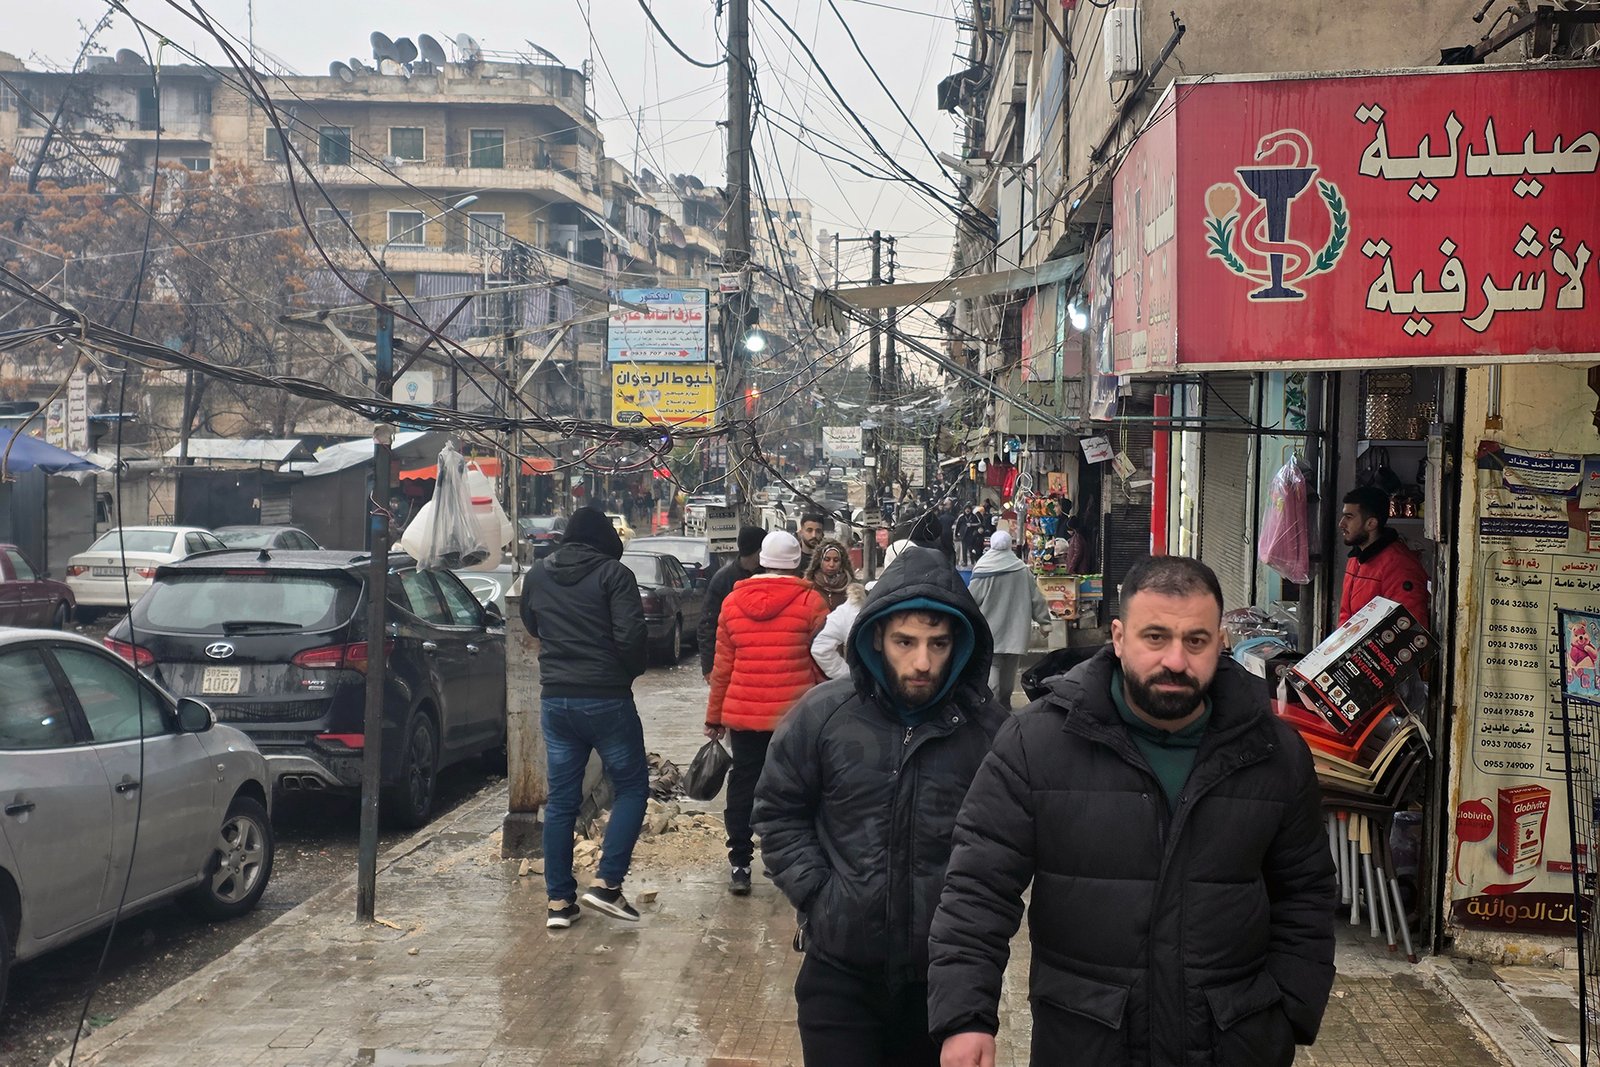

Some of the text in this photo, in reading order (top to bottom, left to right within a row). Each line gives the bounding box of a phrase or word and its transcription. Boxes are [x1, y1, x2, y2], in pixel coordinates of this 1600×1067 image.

[1355, 103, 1600, 201] صيدلية
[1361, 224, 1600, 336] لأشرفية
[640, 292, 672, 302] الدكتور
[674, 308, 702, 323] عارف
[616, 370, 712, 387] خيوط الرضوان
[1531, 460, 1553, 469] أحمد
[1517, 502, 1538, 510] أحمد
[1526, 558, 1540, 569] رقم
[1561, 562, 1598, 573] الإختصاص
[1495, 572, 1543, 586] مشفى الرحمة
[1554, 577, 1575, 587] عامة
[1490, 598, 1539, 608] 0944 324356
[1489, 624, 1537, 635] 0955 836926
[1488, 640, 1507, 649] 0934
[1508, 641, 1538, 651] 378935
[1486, 657, 1507, 666] 0944
[1508, 659, 1539, 669] 981228
[1351, 654, 1384, 689] INVERTER
[204, 677, 239, 692] 1007
[1483, 691, 1534, 702] 0932 230787
[1483, 707, 1534, 718] 0944 978578
[1481, 723, 1535, 736] مشفى عابدين
[1481, 740, 1531, 750] 0933 700567
[1483, 760, 1534, 770] 0955 749009
[1513, 801, 1548, 814] Globivite
[1466, 897, 1546, 924] الدوائية
